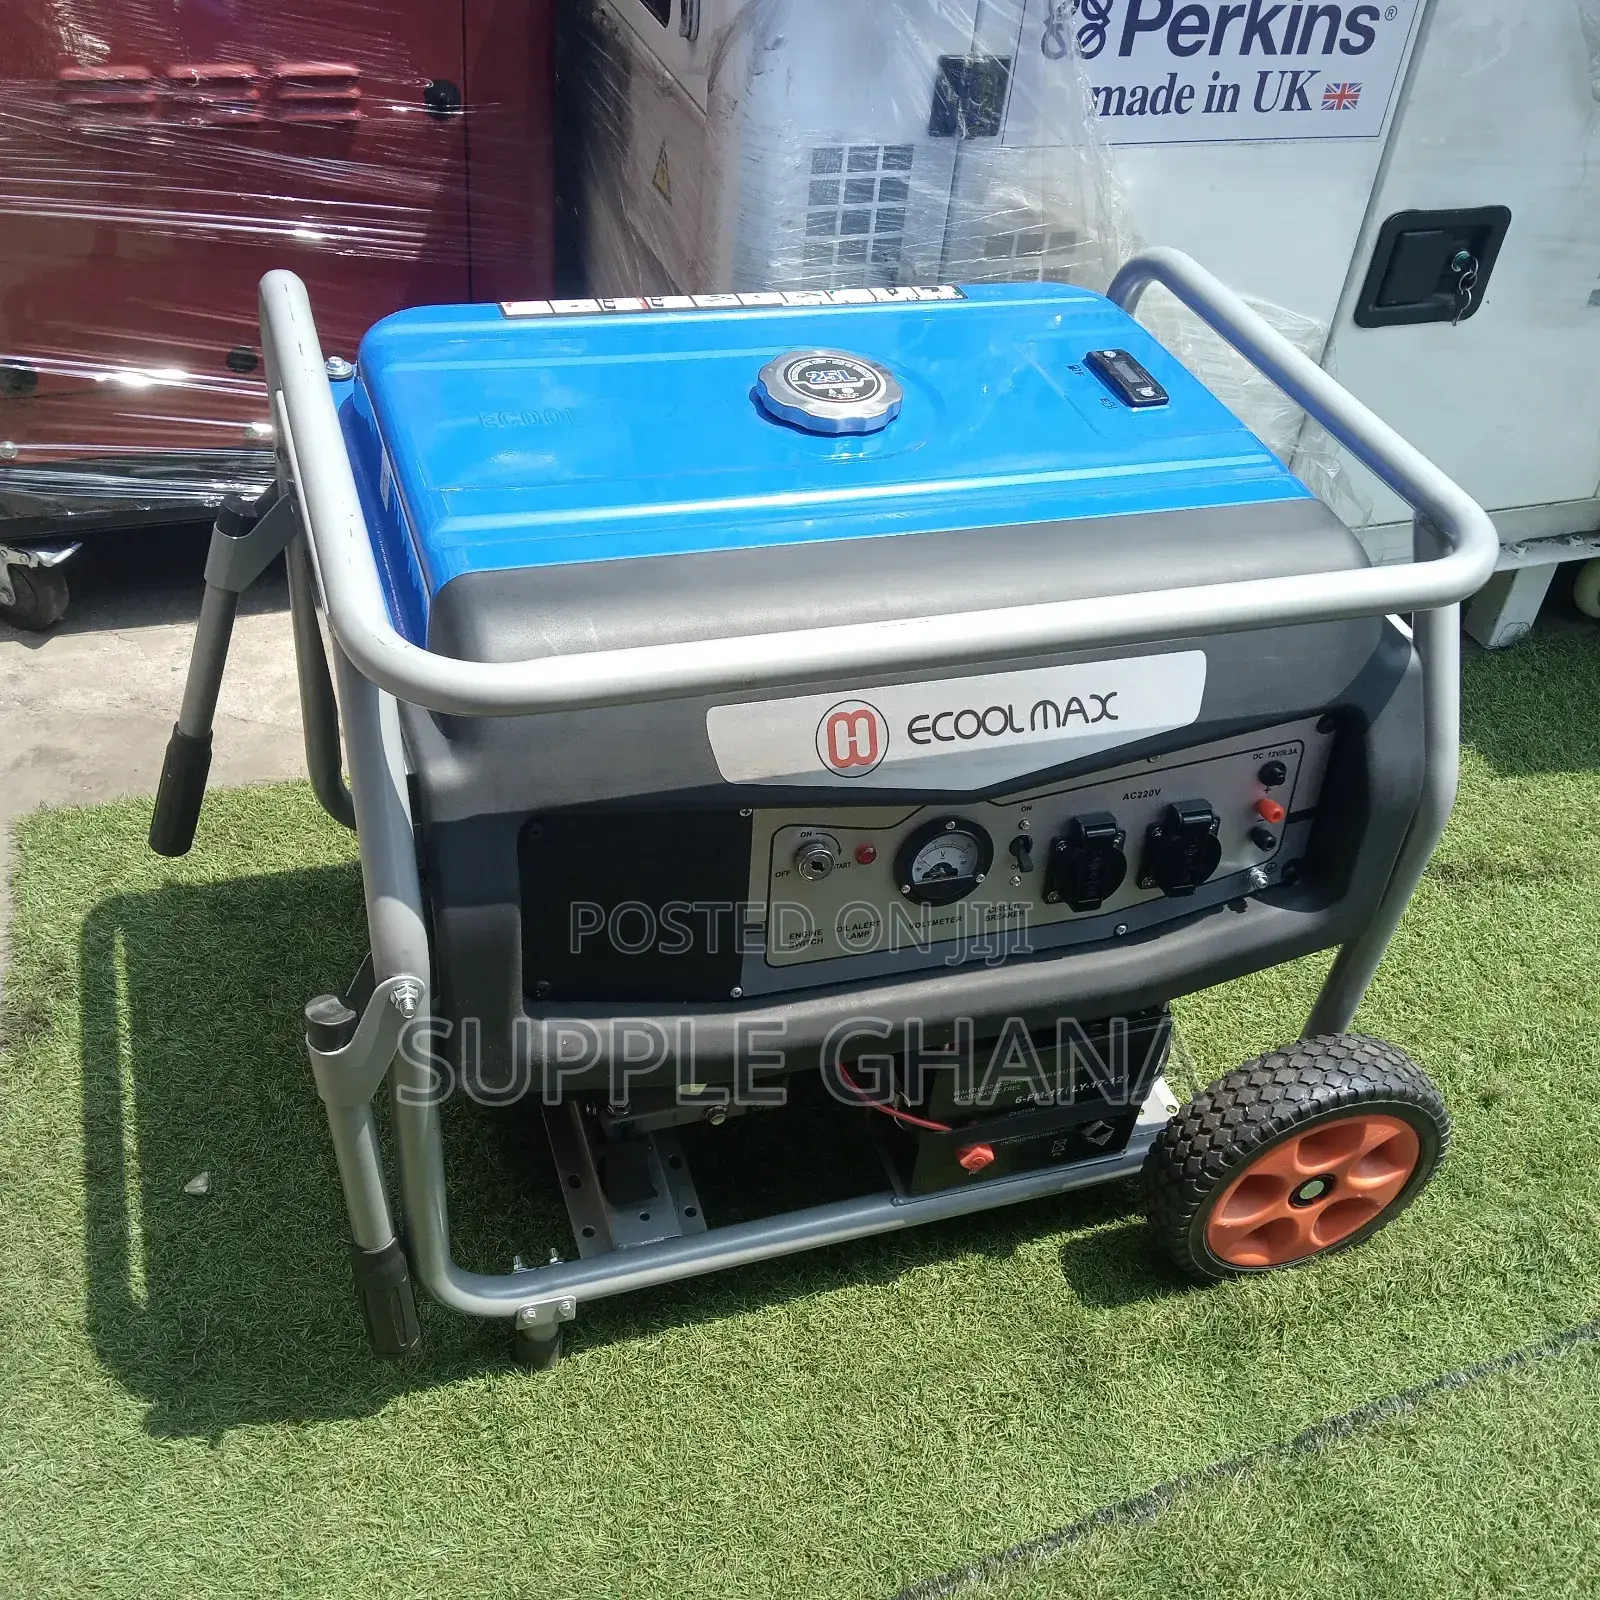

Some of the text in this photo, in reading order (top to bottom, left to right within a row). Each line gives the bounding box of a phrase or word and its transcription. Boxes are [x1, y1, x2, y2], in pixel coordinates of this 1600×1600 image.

[1118, 0, 1381, 57] Perkins
[1093, 69, 1321, 117] made in UK
[805, 369, 858, 384] 25L
[907, 691, 1118, 745] ECOOL MAX
[1253, 752, 1263, 760] DC
[1122, 788, 1162, 801] AC220V
[833, 861, 852, 870] TART
[775, 870, 791, 878] OFF
[985, 910, 1025, 922] BREAKER
[836, 920, 880, 933] OIL ALERT
[909, 916, 962, 929] VOLTMETER
[789, 928, 823, 940] ENGINE
[846, 930, 870, 939] LAMP
[789, 937, 824, 949] SWITCH
[1015, 1087, 1064, 1104] 6-FM-17
[1008, 1107, 1036, 1117] CAUTION
